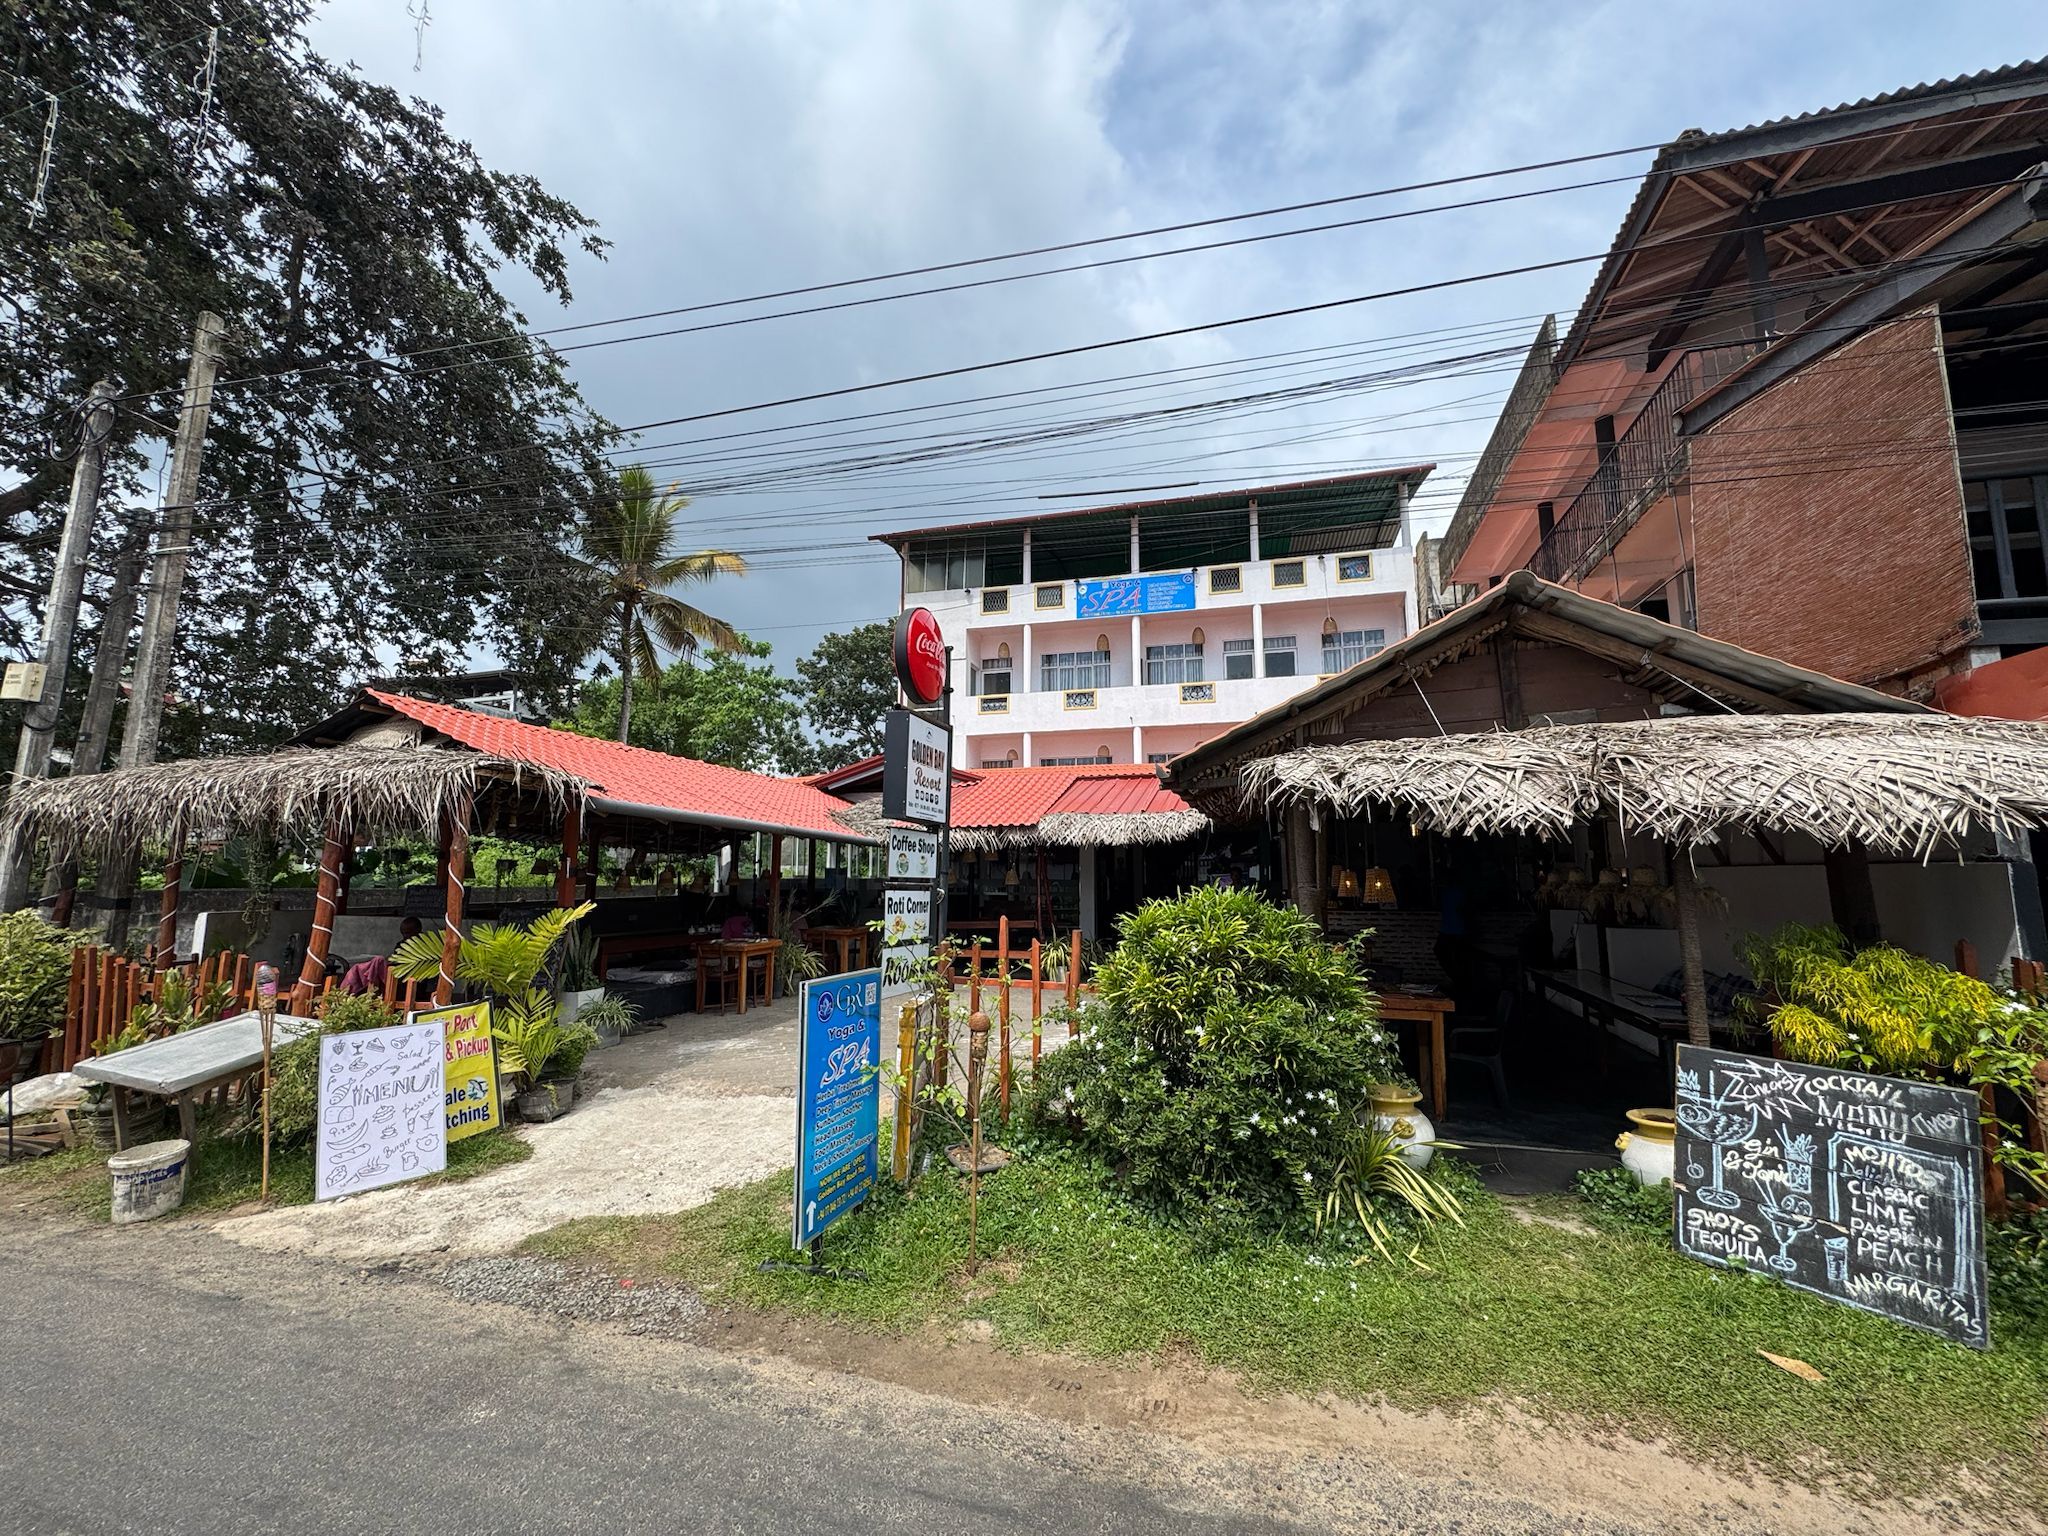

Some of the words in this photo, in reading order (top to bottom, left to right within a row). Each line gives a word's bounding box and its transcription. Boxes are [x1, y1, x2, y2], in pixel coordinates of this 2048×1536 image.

[1080, 587, 1142, 613] SPA
[911, 739, 934, 768] GOLDEN
[934, 748, 946, 773] BAY
[913, 767, 942, 792] Resort
[891, 834, 917, 852] Coffee
[918, 838, 935, 858] Shop
[887, 897, 905, 915] Roti
[906, 897, 929, 914] Corner
[454, 1013, 478, 1034] Port
[828, 1023, 856, 1041] Yoga
[856, 1018, 866, 1032] &
[397, 1048, 424, 1061] Salad
[445, 1042, 455, 1062] &
[455, 1036, 489, 1059] Pickup
[820, 1036, 871, 1088] SPA
[363, 1074, 430, 1105] MENU
[445, 1087, 466, 1106] ale
[446, 1102, 490, 1130] tching
[816, 1103, 833, 1118] Deep
[1815, 1095, 1909, 1144] MENU
[383, 1138, 411, 1159] Burger
[1742, 1138, 1779, 1160] Gin
[1687, 1208, 1762, 1242] SHOTS
[1857, 1237, 1943, 1273] PEACH
